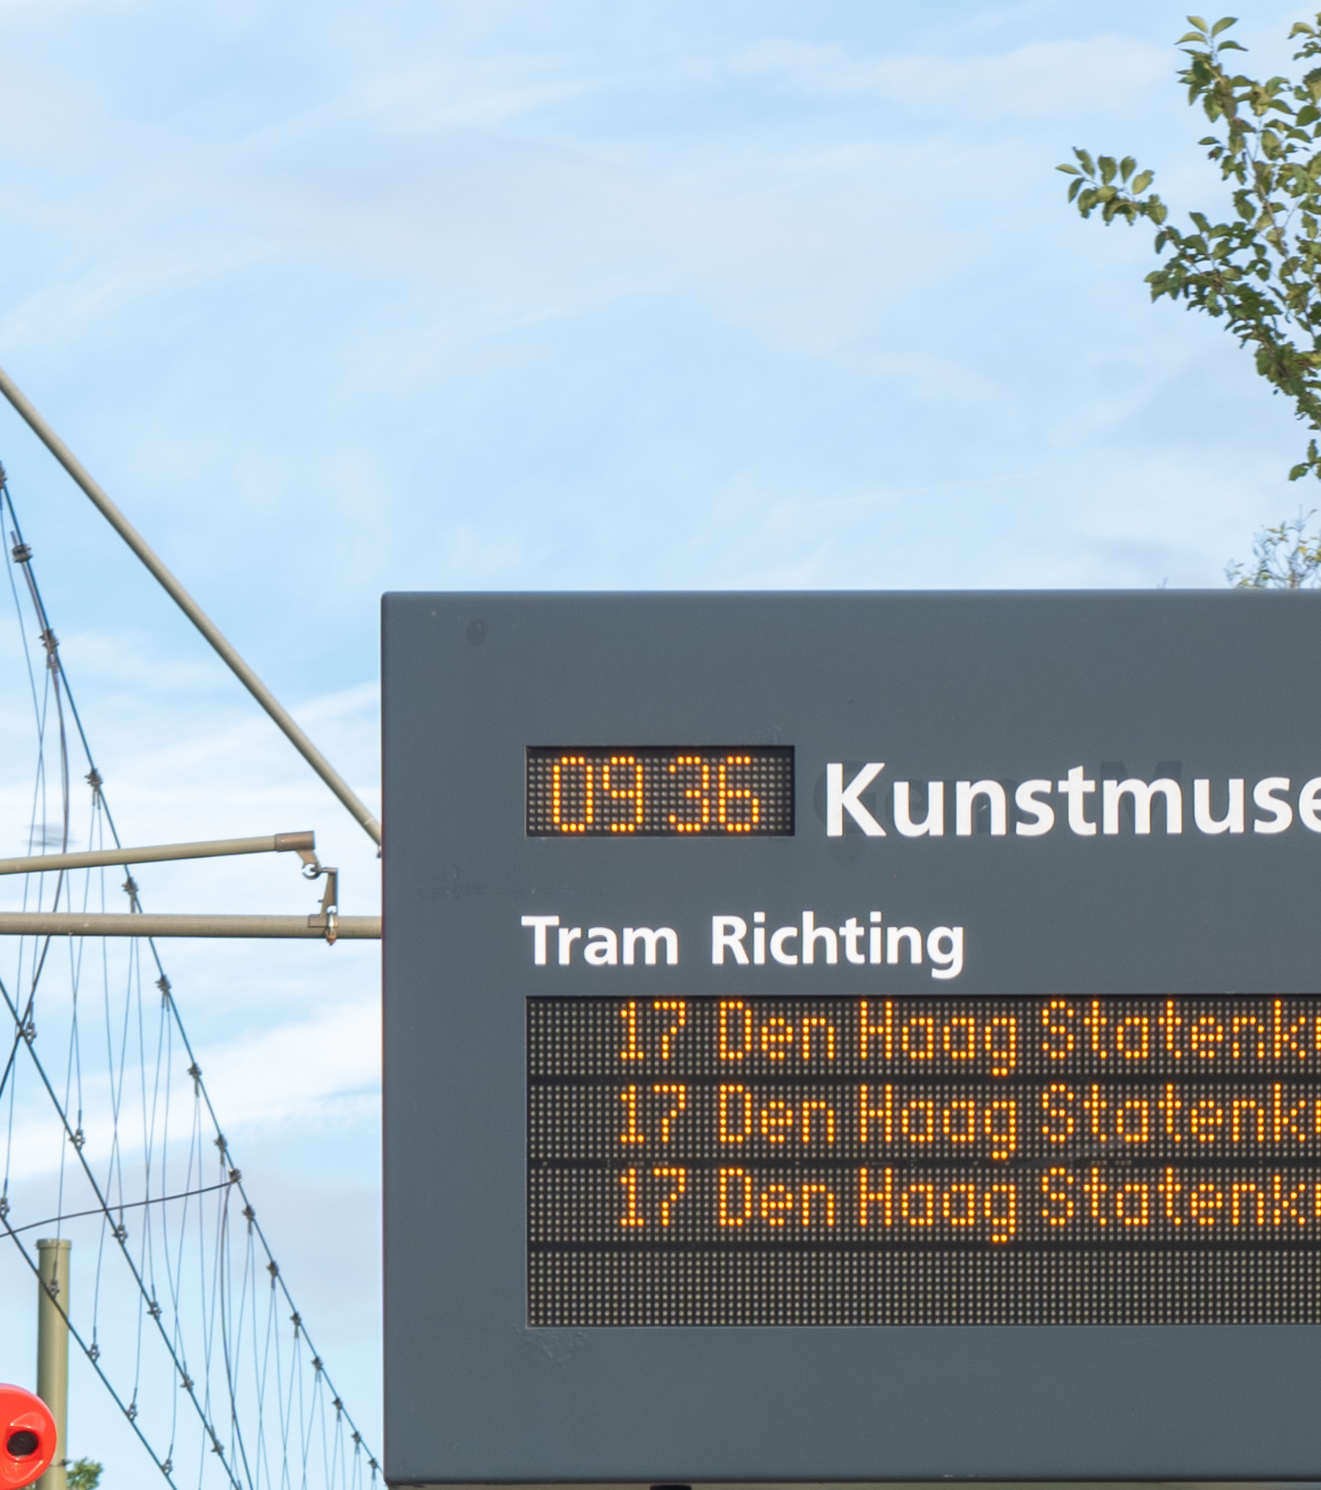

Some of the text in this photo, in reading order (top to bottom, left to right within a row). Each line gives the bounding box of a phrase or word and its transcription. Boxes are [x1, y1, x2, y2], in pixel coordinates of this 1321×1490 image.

[521, 914, 679, 967] Tram
[710, 910, 965, 981] Richting
[619, 1000, 687, 1062] 17
[718, 1000, 836, 1062] Den
[859, 1000, 1018, 1074] Haag
[619, 1083, 687, 1145] 17
[718, 1083, 836, 1145] Den
[859, 1083, 1018, 1158] Haag
[619, 1166, 687, 1228] 17
[718, 1166, 836, 1228] Den
[859, 1166, 1018, 1243] Haag
